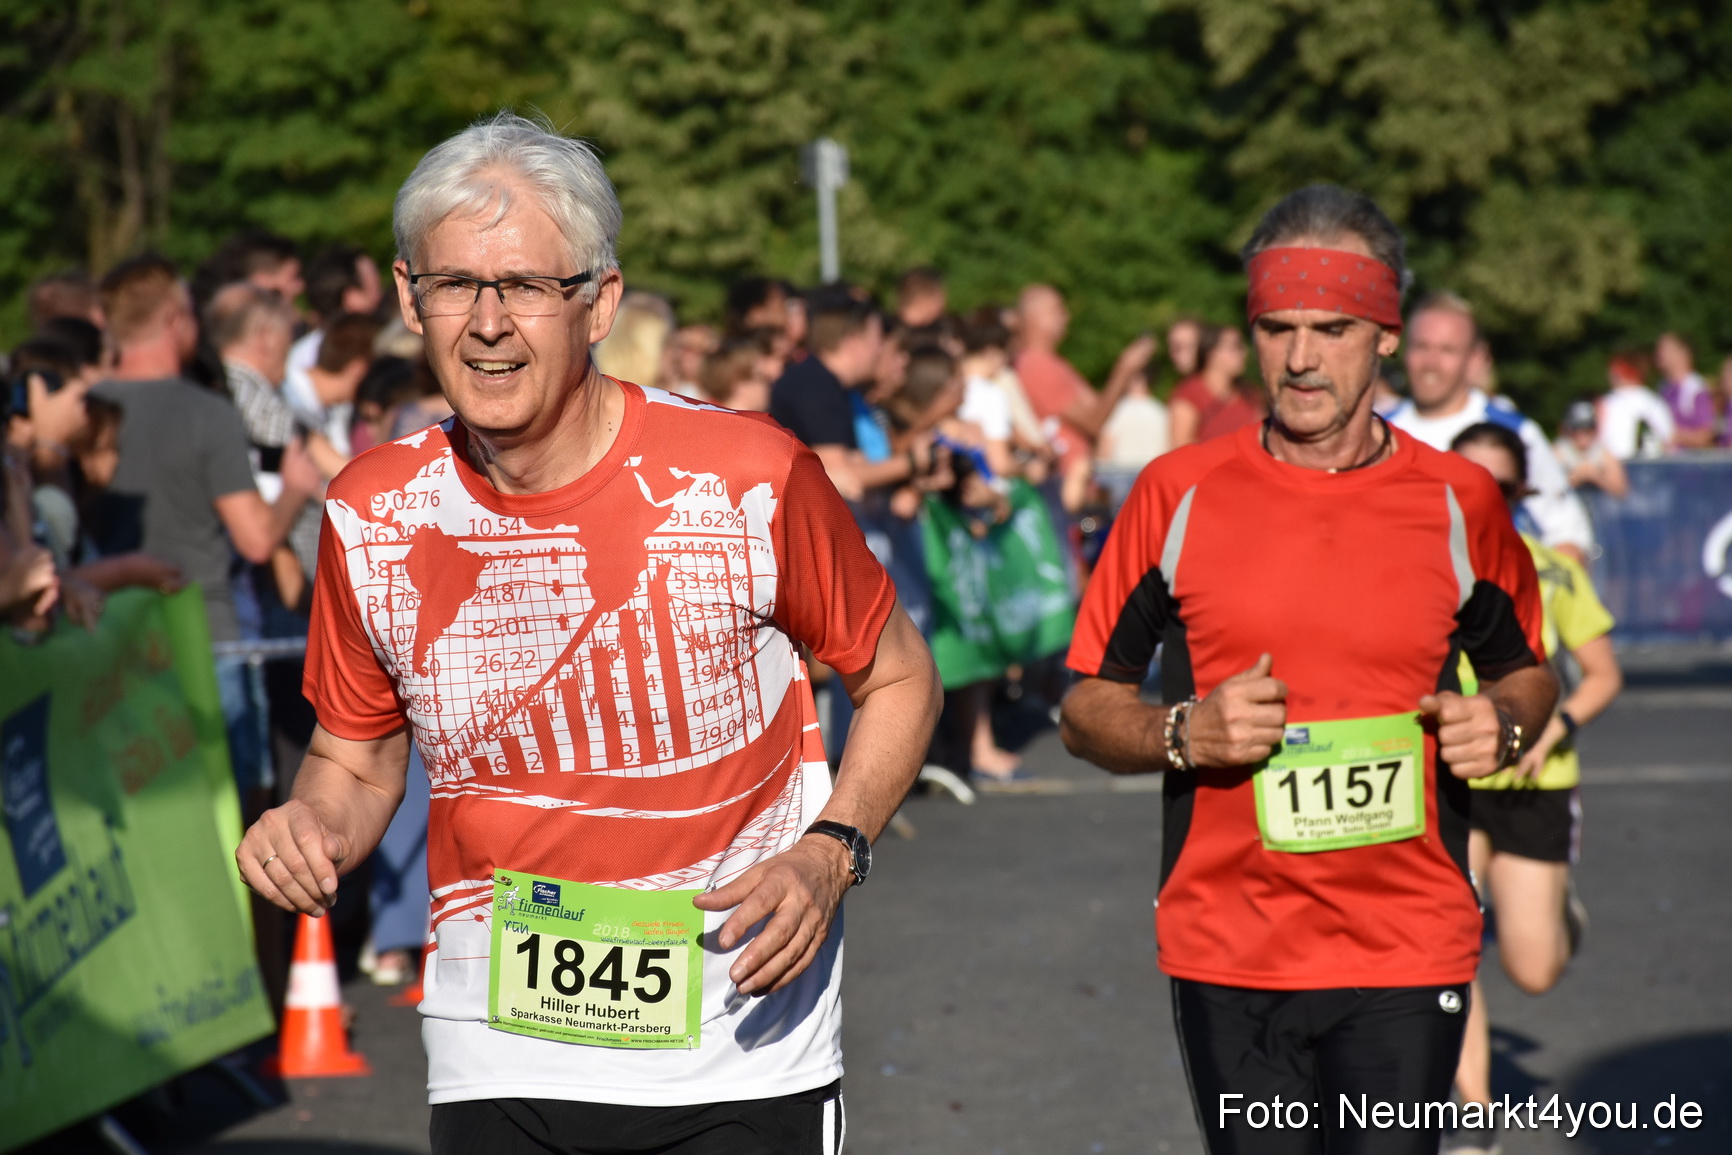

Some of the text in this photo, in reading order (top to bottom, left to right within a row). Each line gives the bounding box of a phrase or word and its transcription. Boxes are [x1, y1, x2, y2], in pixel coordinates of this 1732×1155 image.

[468, 517, 522, 536] 10.54
[669, 510, 744, 529] 91.62%
[472, 616, 533, 639] 52.01
[474, 650, 537, 674] 26.22
[1278, 761, 1402, 813] 1157
[1335, 810, 1394, 825] Wolfgang
[518, 912, 548, 921] neumarkt
[519, 898, 586, 921] firmenlauf
[592, 923, 631, 938] 2018
[516, 934, 672, 1004] 1845
[540, 996, 640, 1020] Hiller Hubert
[510, 1007, 672, 1036] Sparkasse Neumarkt-Parsberg
